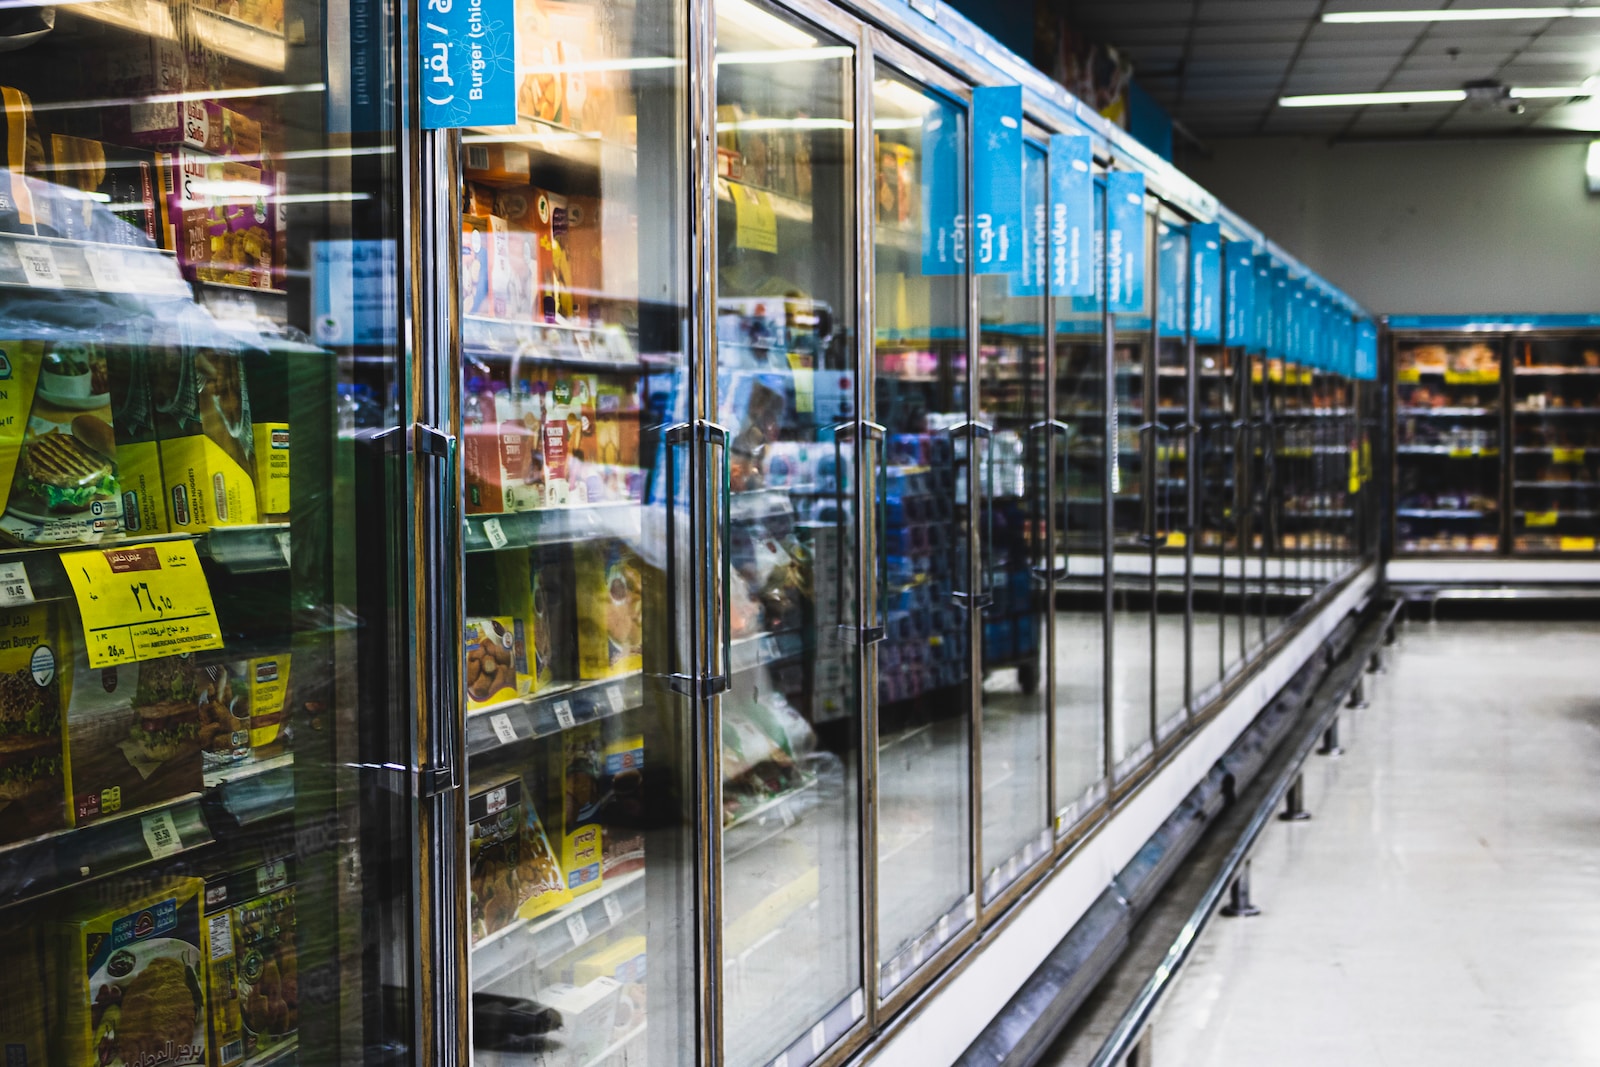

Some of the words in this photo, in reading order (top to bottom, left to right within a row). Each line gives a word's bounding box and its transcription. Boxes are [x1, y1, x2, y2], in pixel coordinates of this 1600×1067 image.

[424, 42, 454, 87] بقر
[469, 42, 485, 100] Burger
[187, 121, 204, 143] Sadia
[139, 474, 148, 503] NUGGETS
[188, 467, 197, 497] NUGGETS
[143, 504, 151, 531] CHICKEN
[191, 498, 200, 525] CHICKEN
[109, 554, 127, 564] خاص
[127, 553, 142, 561] عرض
[6, 586, 24, 596] 19.45
[13, 635, 40, 648] Burger
[151, 638, 177, 649] AMERICANA
[177, 636, 195, 644] CHICKEN
